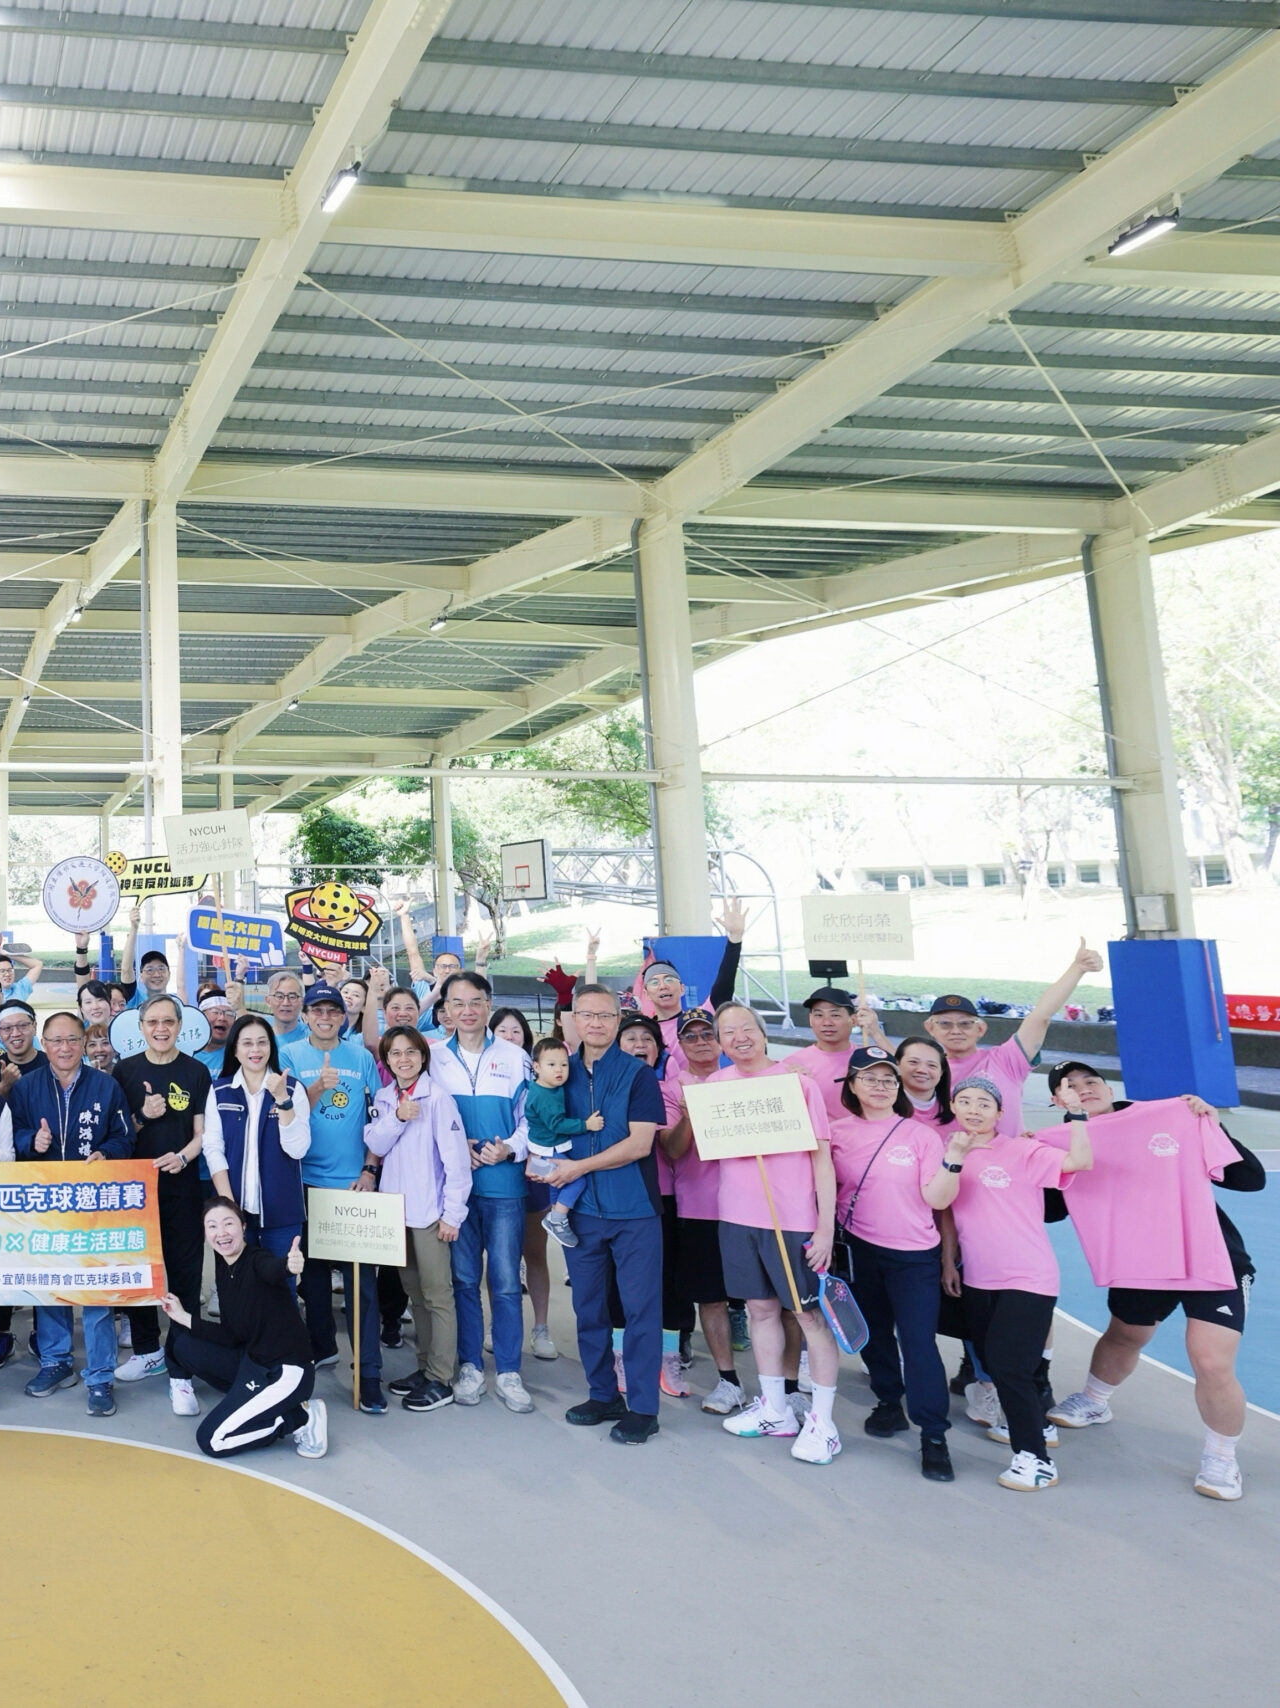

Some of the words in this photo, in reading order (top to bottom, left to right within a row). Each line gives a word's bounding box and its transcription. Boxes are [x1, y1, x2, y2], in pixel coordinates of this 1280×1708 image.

[189, 825, 226, 837] NYCUH
[823, 913, 891, 928] 欣欣向榮
[307, 945, 341, 961] NYCUH
[1226, 1003, 1280, 1021] 總醫
[710, 1097, 785, 1120] 王者榮耀
[334, 1206, 377, 1218] NYCUH
[29, 1227, 146, 1254] 健康生活型態
